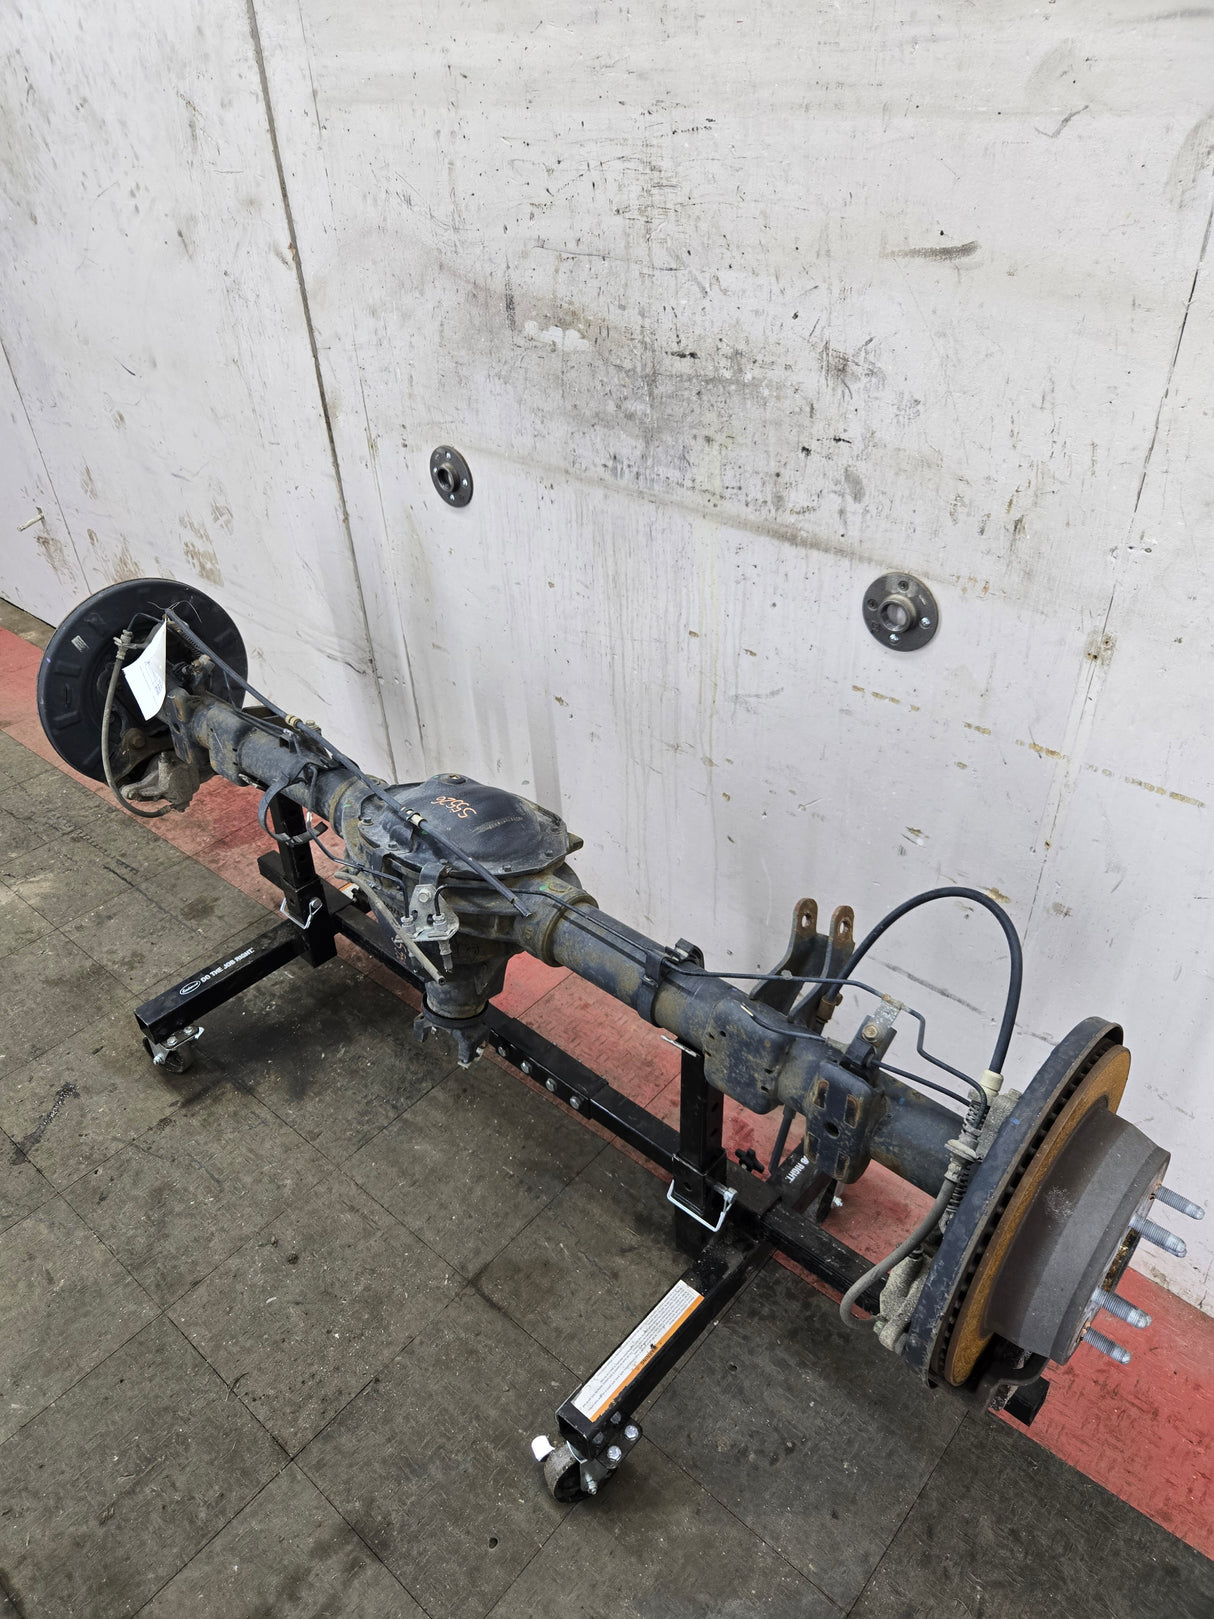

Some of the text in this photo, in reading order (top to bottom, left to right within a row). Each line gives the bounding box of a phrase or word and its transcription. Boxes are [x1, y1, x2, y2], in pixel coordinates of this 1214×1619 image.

[200, 974, 211, 983] DO
[210, 966, 223, 977] THE
[223, 959, 236, 970] JOB
